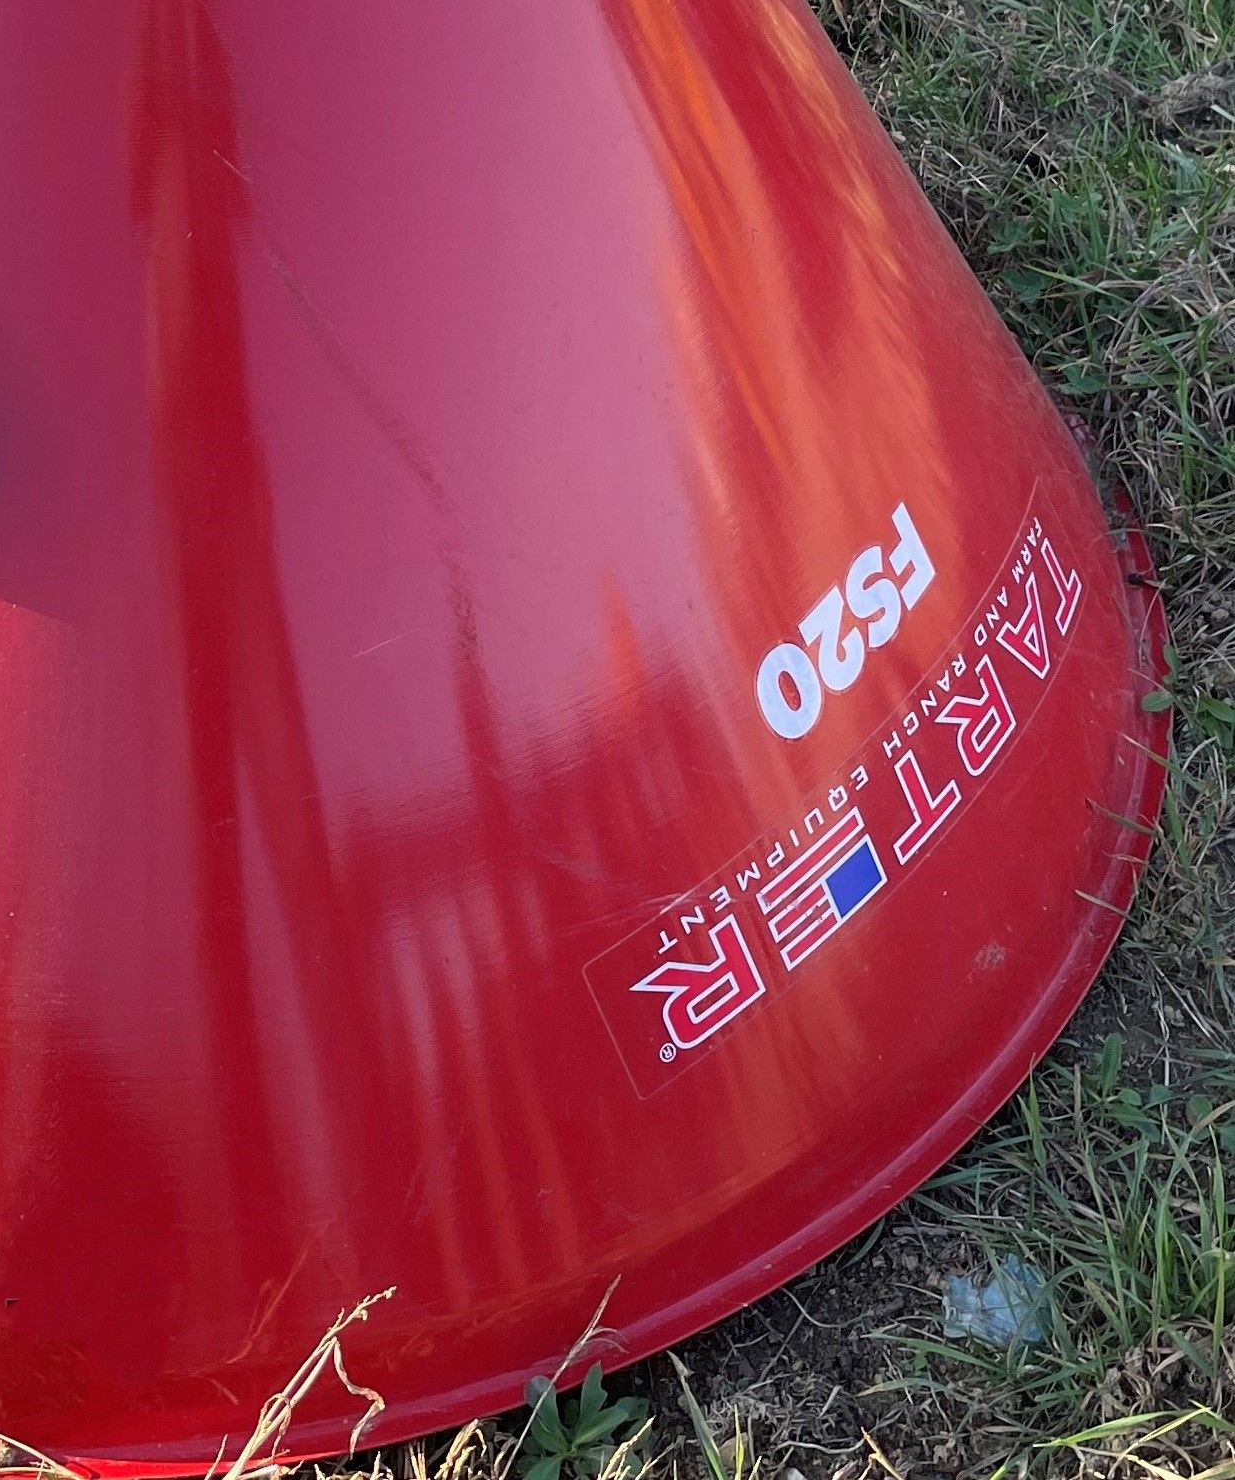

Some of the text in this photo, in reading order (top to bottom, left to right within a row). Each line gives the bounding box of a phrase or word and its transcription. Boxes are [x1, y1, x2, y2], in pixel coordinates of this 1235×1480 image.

[629, 538, 1082, 1050] TARTER
[658, 516, 1043, 954] FARM AND RANCH EQUIPMENT
[756, 501, 936, 740] FS20
